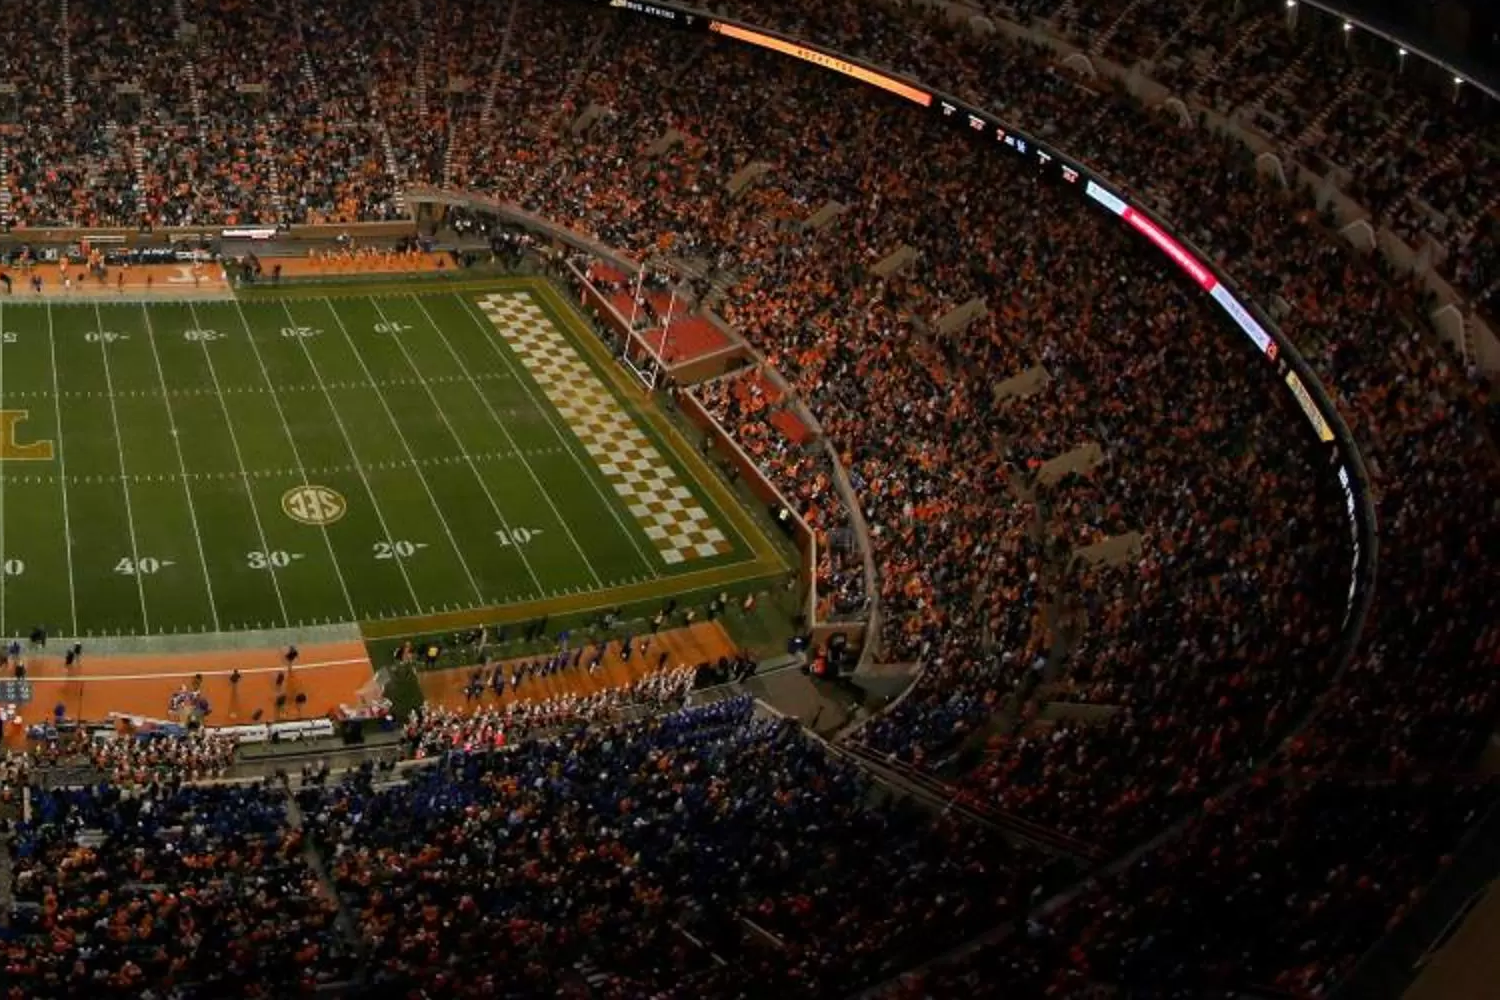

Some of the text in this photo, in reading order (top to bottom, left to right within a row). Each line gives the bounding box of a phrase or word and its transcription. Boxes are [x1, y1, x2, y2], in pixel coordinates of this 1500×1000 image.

[289, 489, 341, 518] SEC
[494, 526, 532, 546] 10
[372, 540, 415, 559] 20
[114, 556, 160, 575] 40
[247, 550, 291, 569] 30
